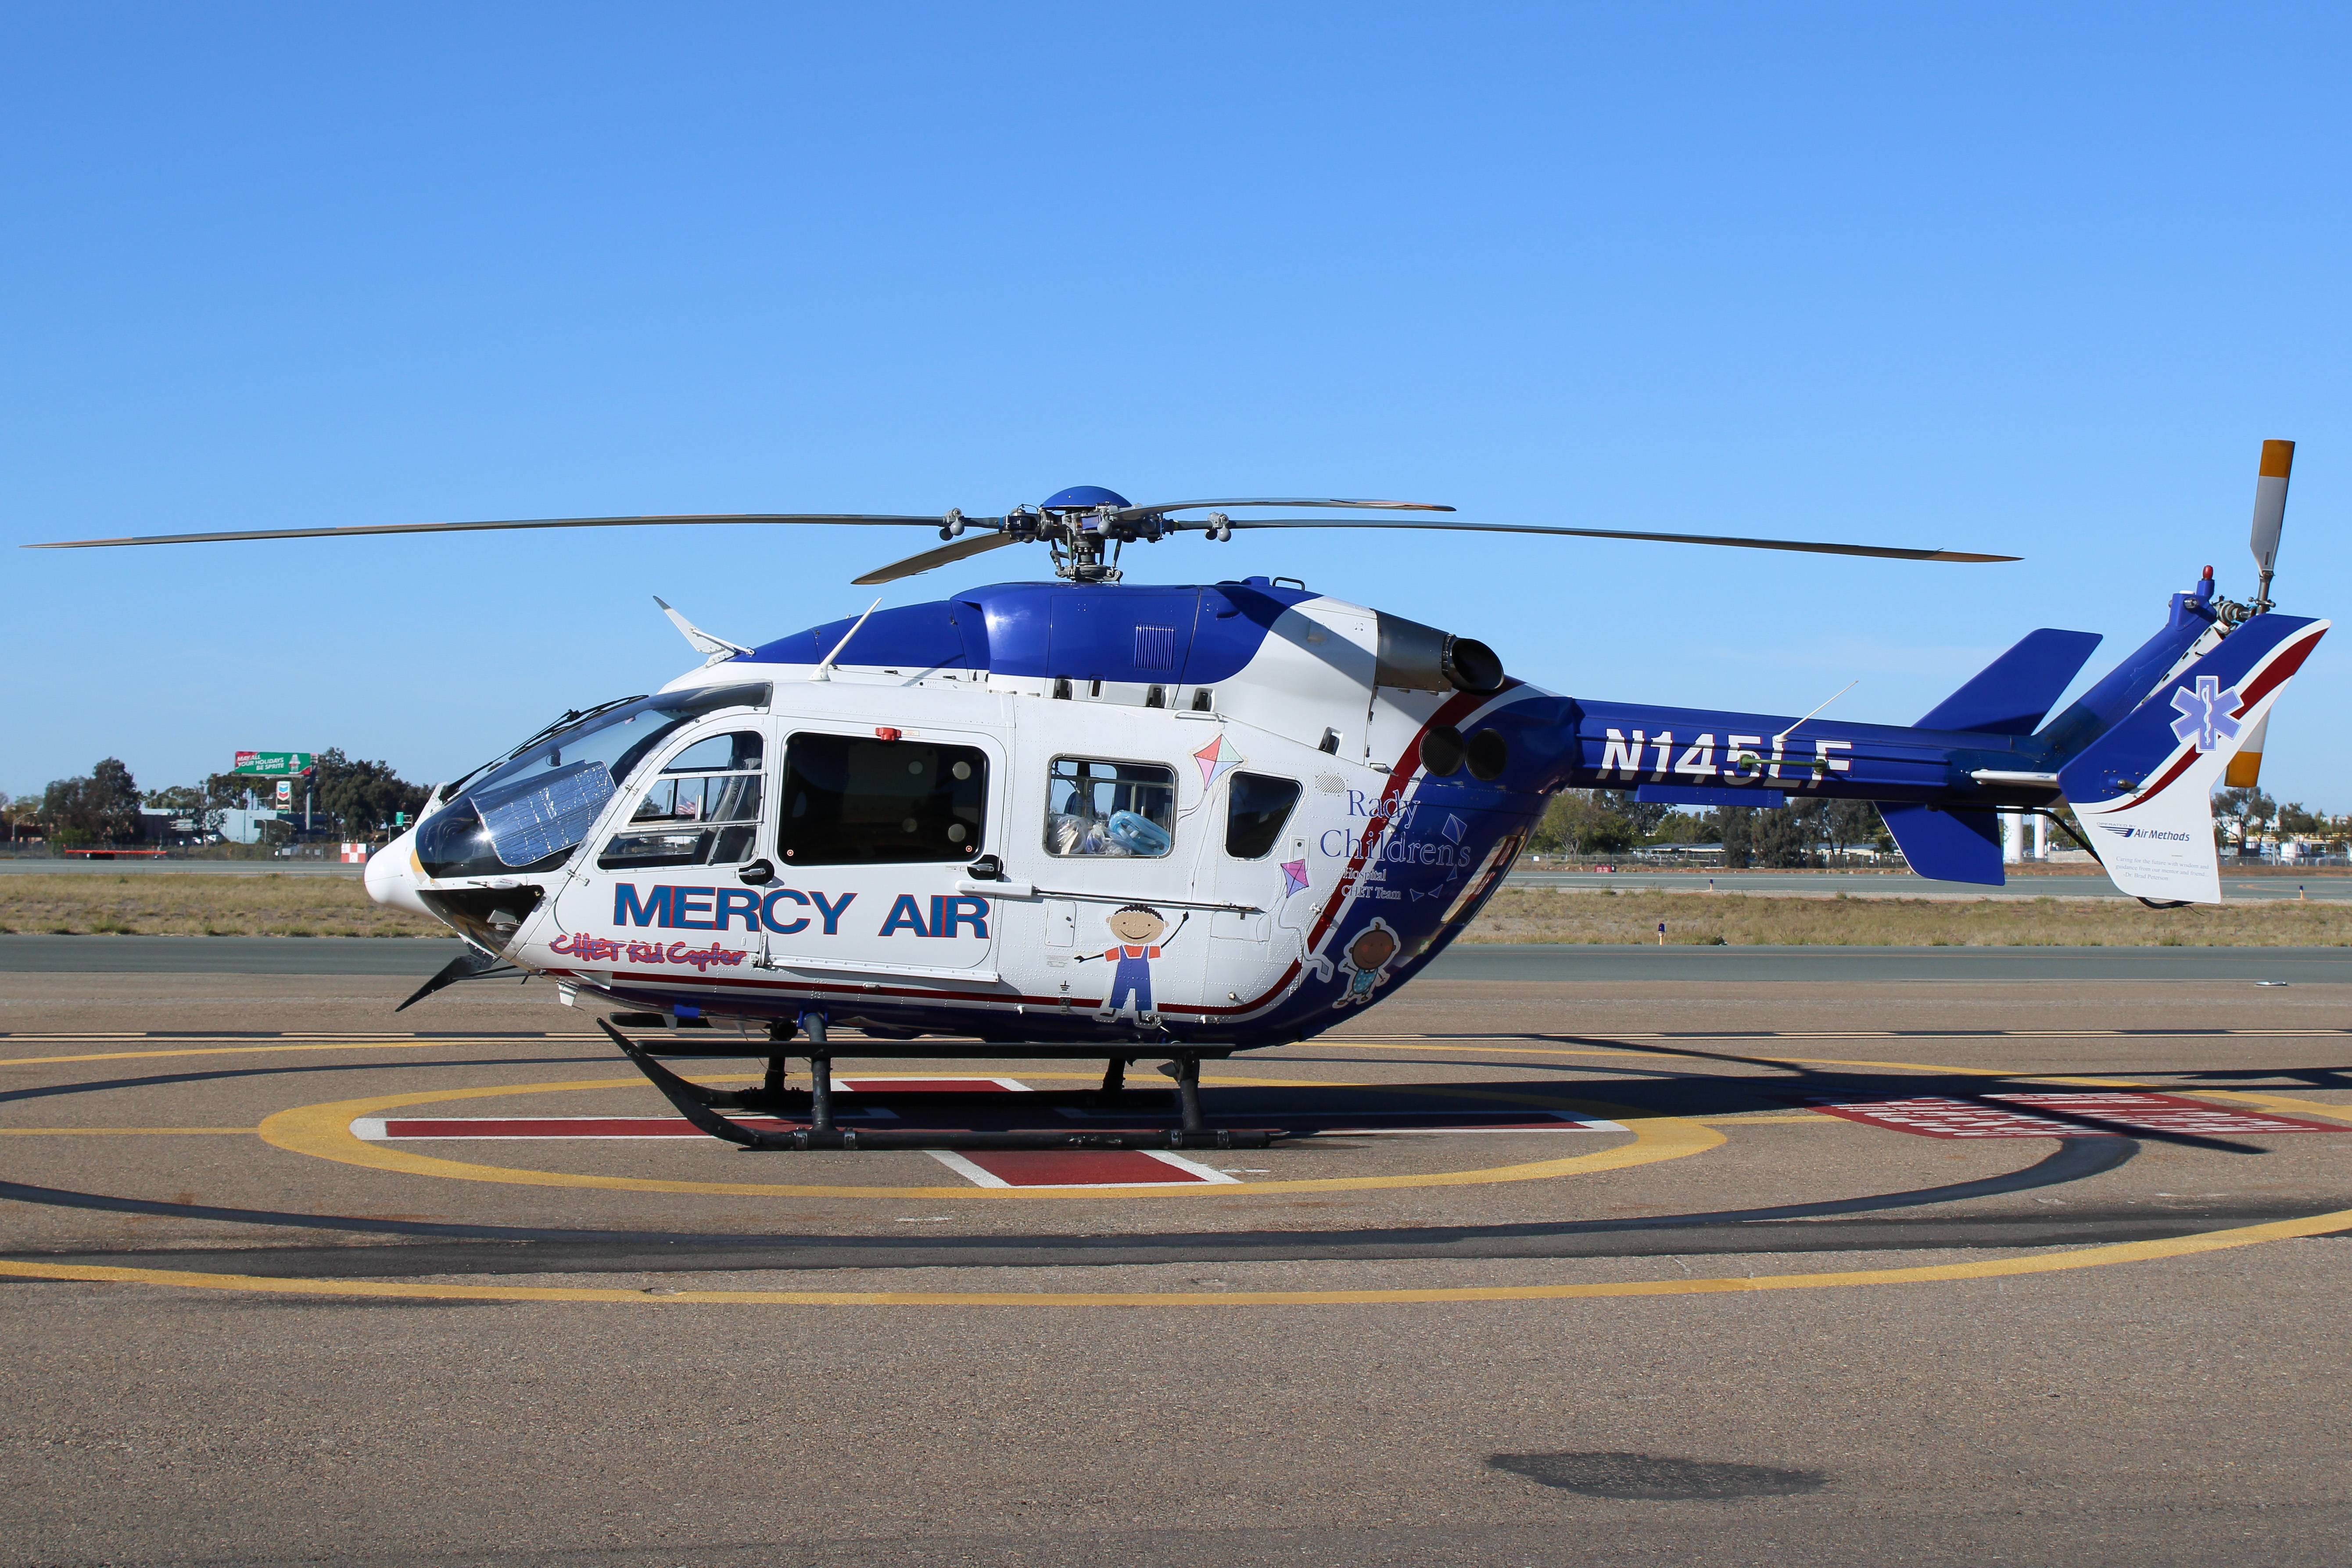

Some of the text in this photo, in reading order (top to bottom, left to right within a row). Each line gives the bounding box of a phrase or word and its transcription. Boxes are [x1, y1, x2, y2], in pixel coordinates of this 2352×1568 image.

[255, 757, 284, 765] HOLIDAYS
[1596, 728, 1852, 789] N145LF
[1347, 789, 1420, 829] Rady
[2133, 829, 2190, 841] Air Methods
[1343, 867, 1386, 883] Hospital
[1341, 886, 1401, 900] CHET Team
[613, 883, 990, 939] MERCY AIR
[549, 933, 746, 972] CHET Kid Copter
